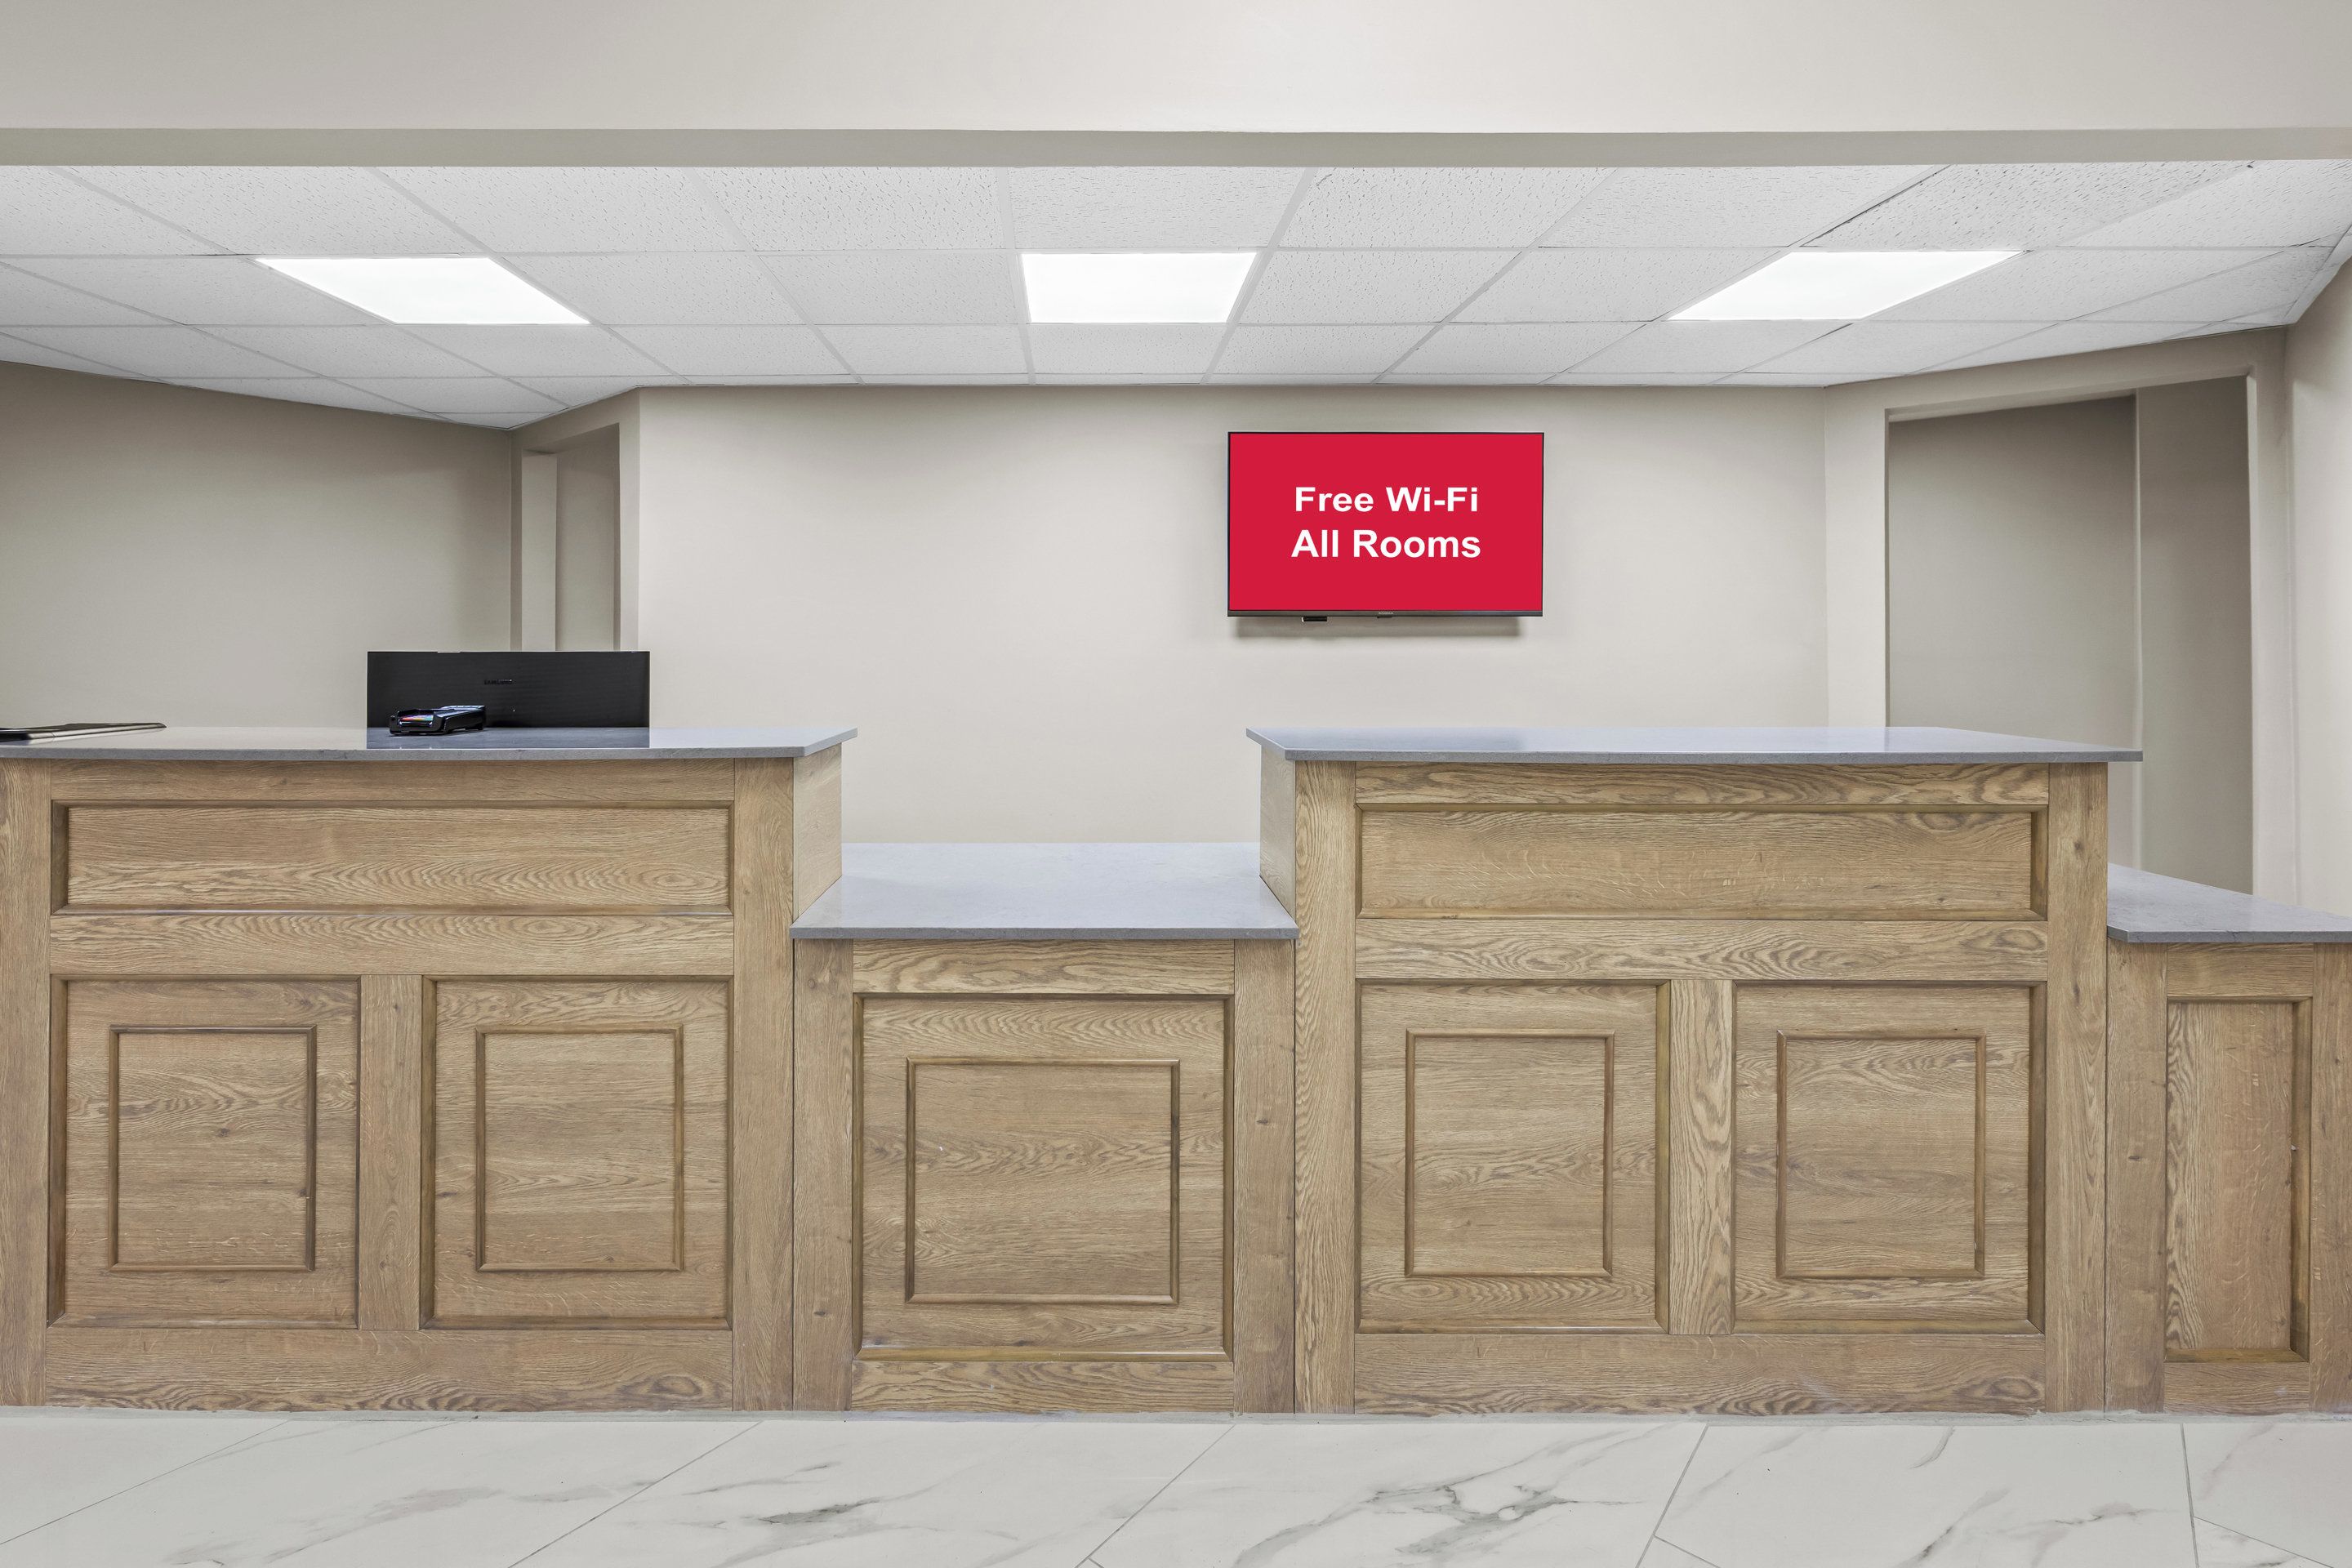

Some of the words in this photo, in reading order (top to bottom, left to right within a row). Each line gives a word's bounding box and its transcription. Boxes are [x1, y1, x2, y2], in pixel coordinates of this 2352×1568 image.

[1295, 487, 1374, 512] Free
[1386, 487, 1478, 512] Wi-Fi
[1291, 529, 1339, 558] All
[1353, 529, 1481, 559] Rooms
